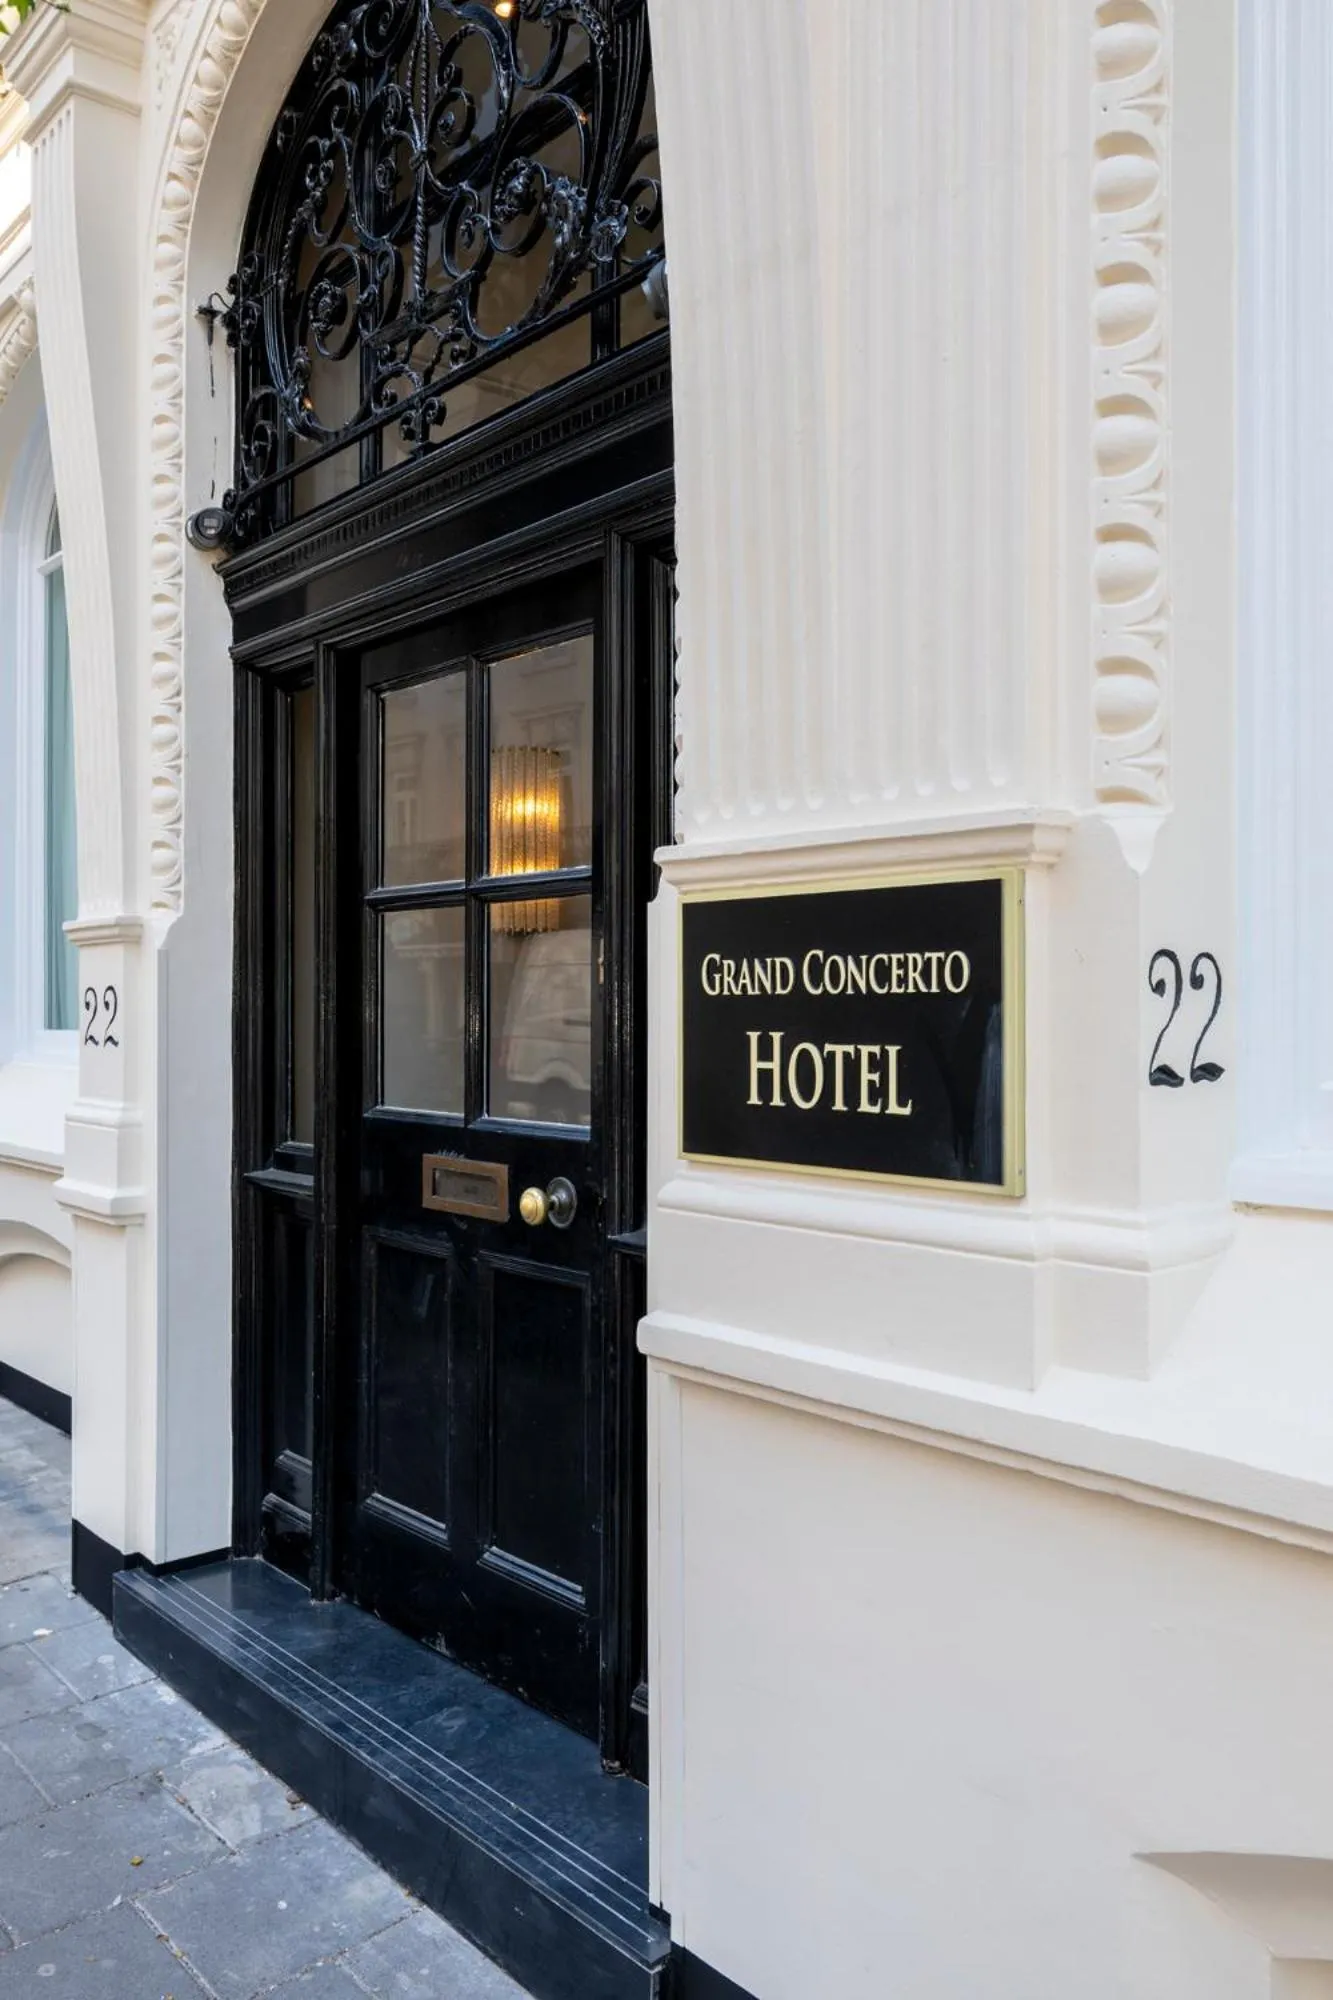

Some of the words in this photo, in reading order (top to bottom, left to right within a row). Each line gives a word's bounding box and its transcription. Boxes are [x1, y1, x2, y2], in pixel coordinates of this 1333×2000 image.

[701, 952, 794, 996] GRAND
[802, 948, 971, 995] CONCERTO
[84, 985, 119, 1047] 22
[1148, 948, 1225, 1088] 22
[746, 1031, 913, 1115] HOTEL
